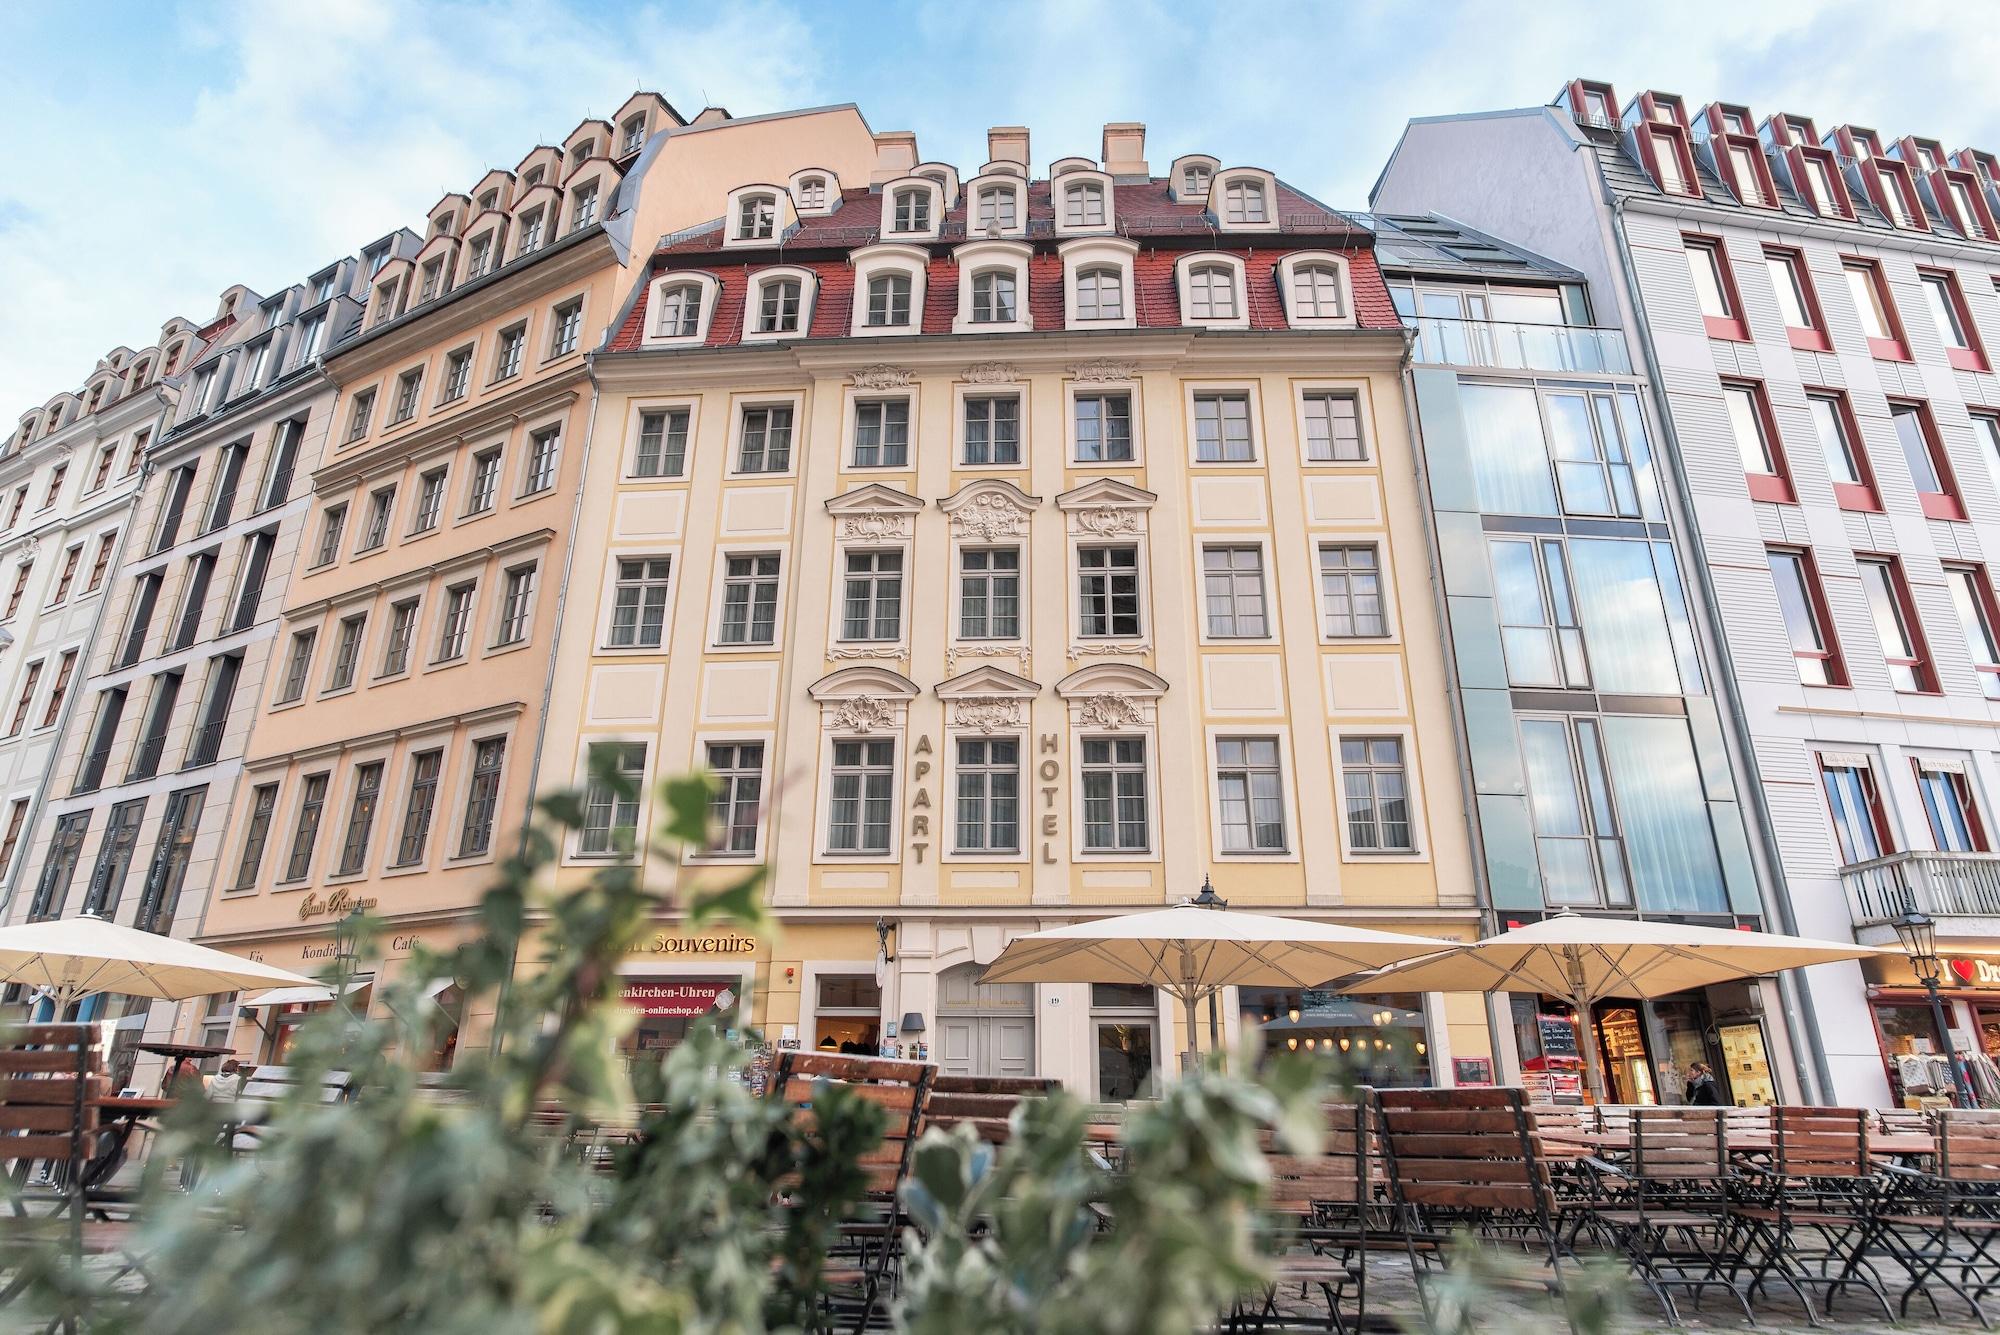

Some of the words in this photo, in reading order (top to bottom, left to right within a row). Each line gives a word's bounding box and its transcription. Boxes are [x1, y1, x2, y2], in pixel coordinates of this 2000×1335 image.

[912, 734, 933, 865] APART
[1040, 733, 1060, 865] HOTEL
[392, 934, 420, 951] Café
[652, 933, 755, 953] Souvenirs
[1940, 959, 1953, 982] I
